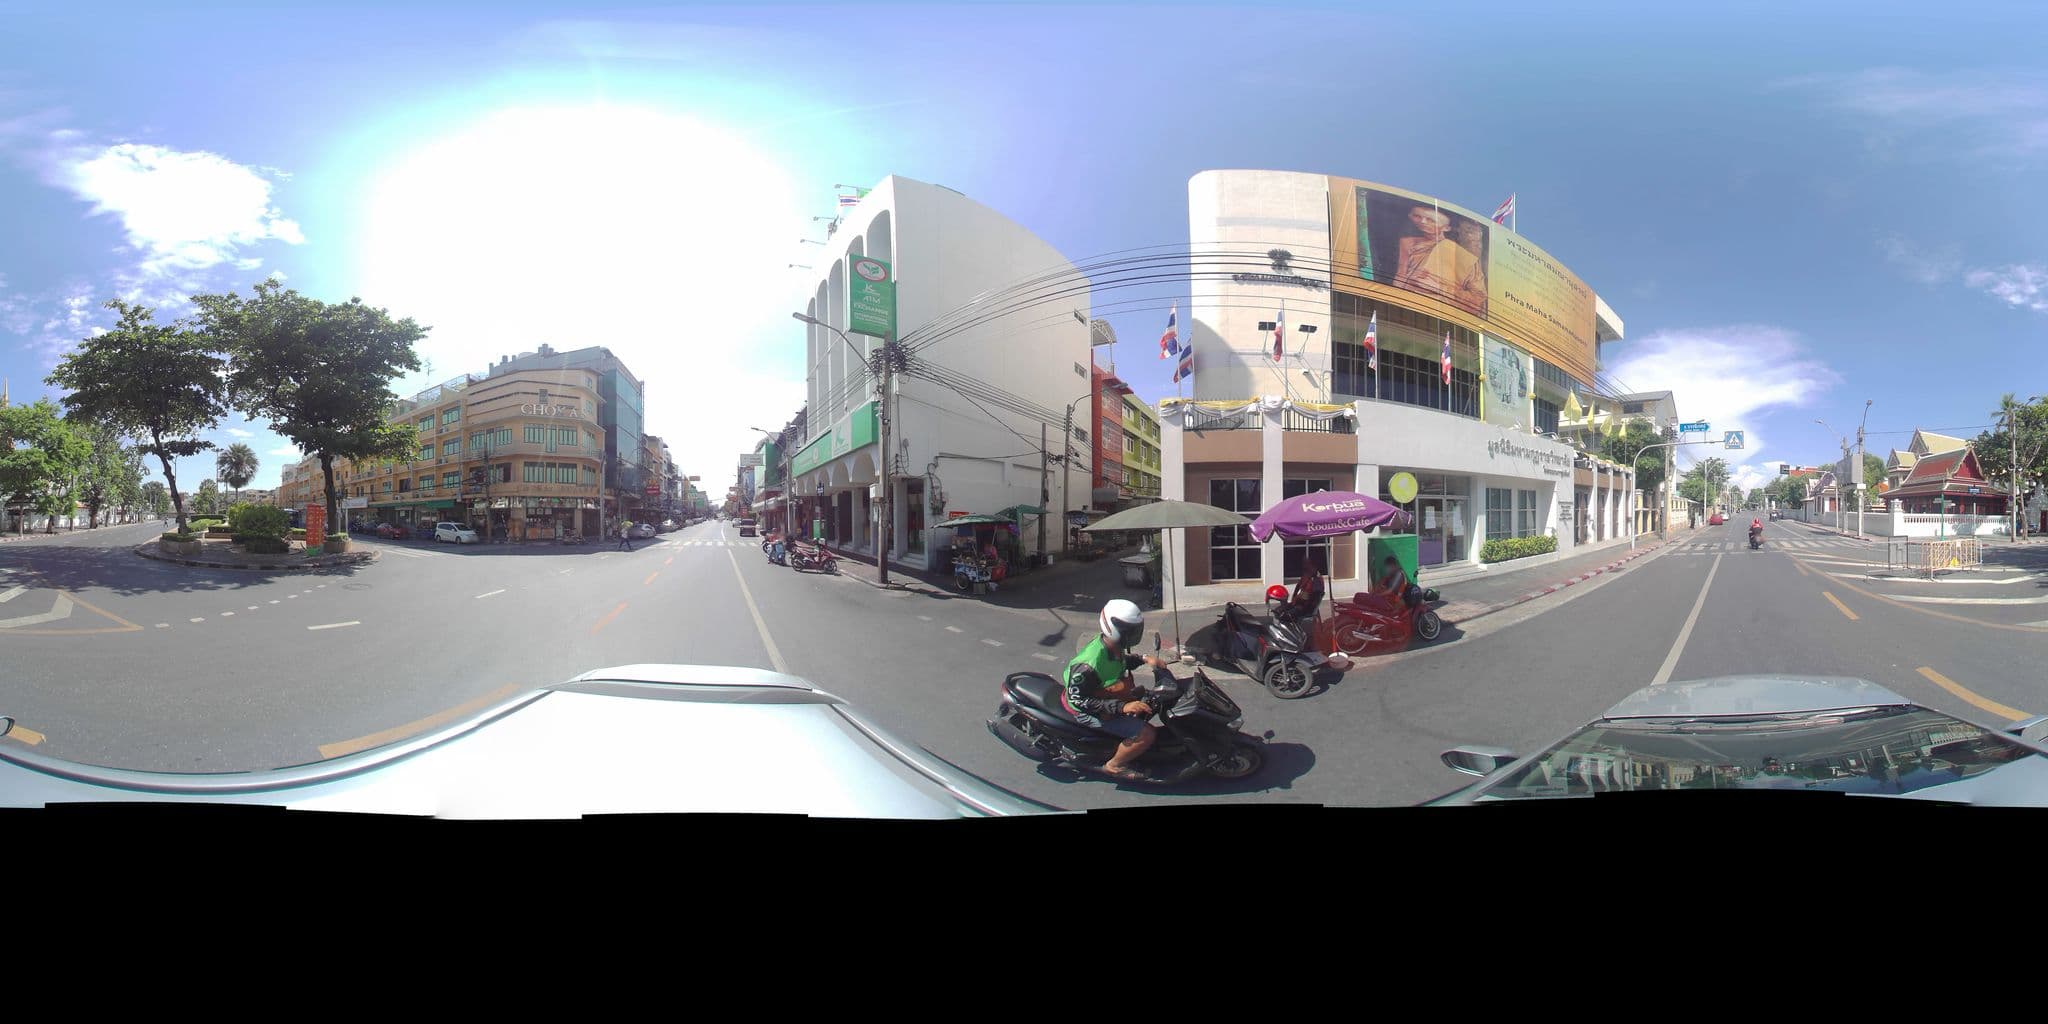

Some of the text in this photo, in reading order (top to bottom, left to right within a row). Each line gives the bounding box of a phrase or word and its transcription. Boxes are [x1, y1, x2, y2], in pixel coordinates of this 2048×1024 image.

[1505, 291, 1524, 306] Phra
[1526, 302, 1547, 319] Maha
[1302, 501, 1365, 512] Korbua
